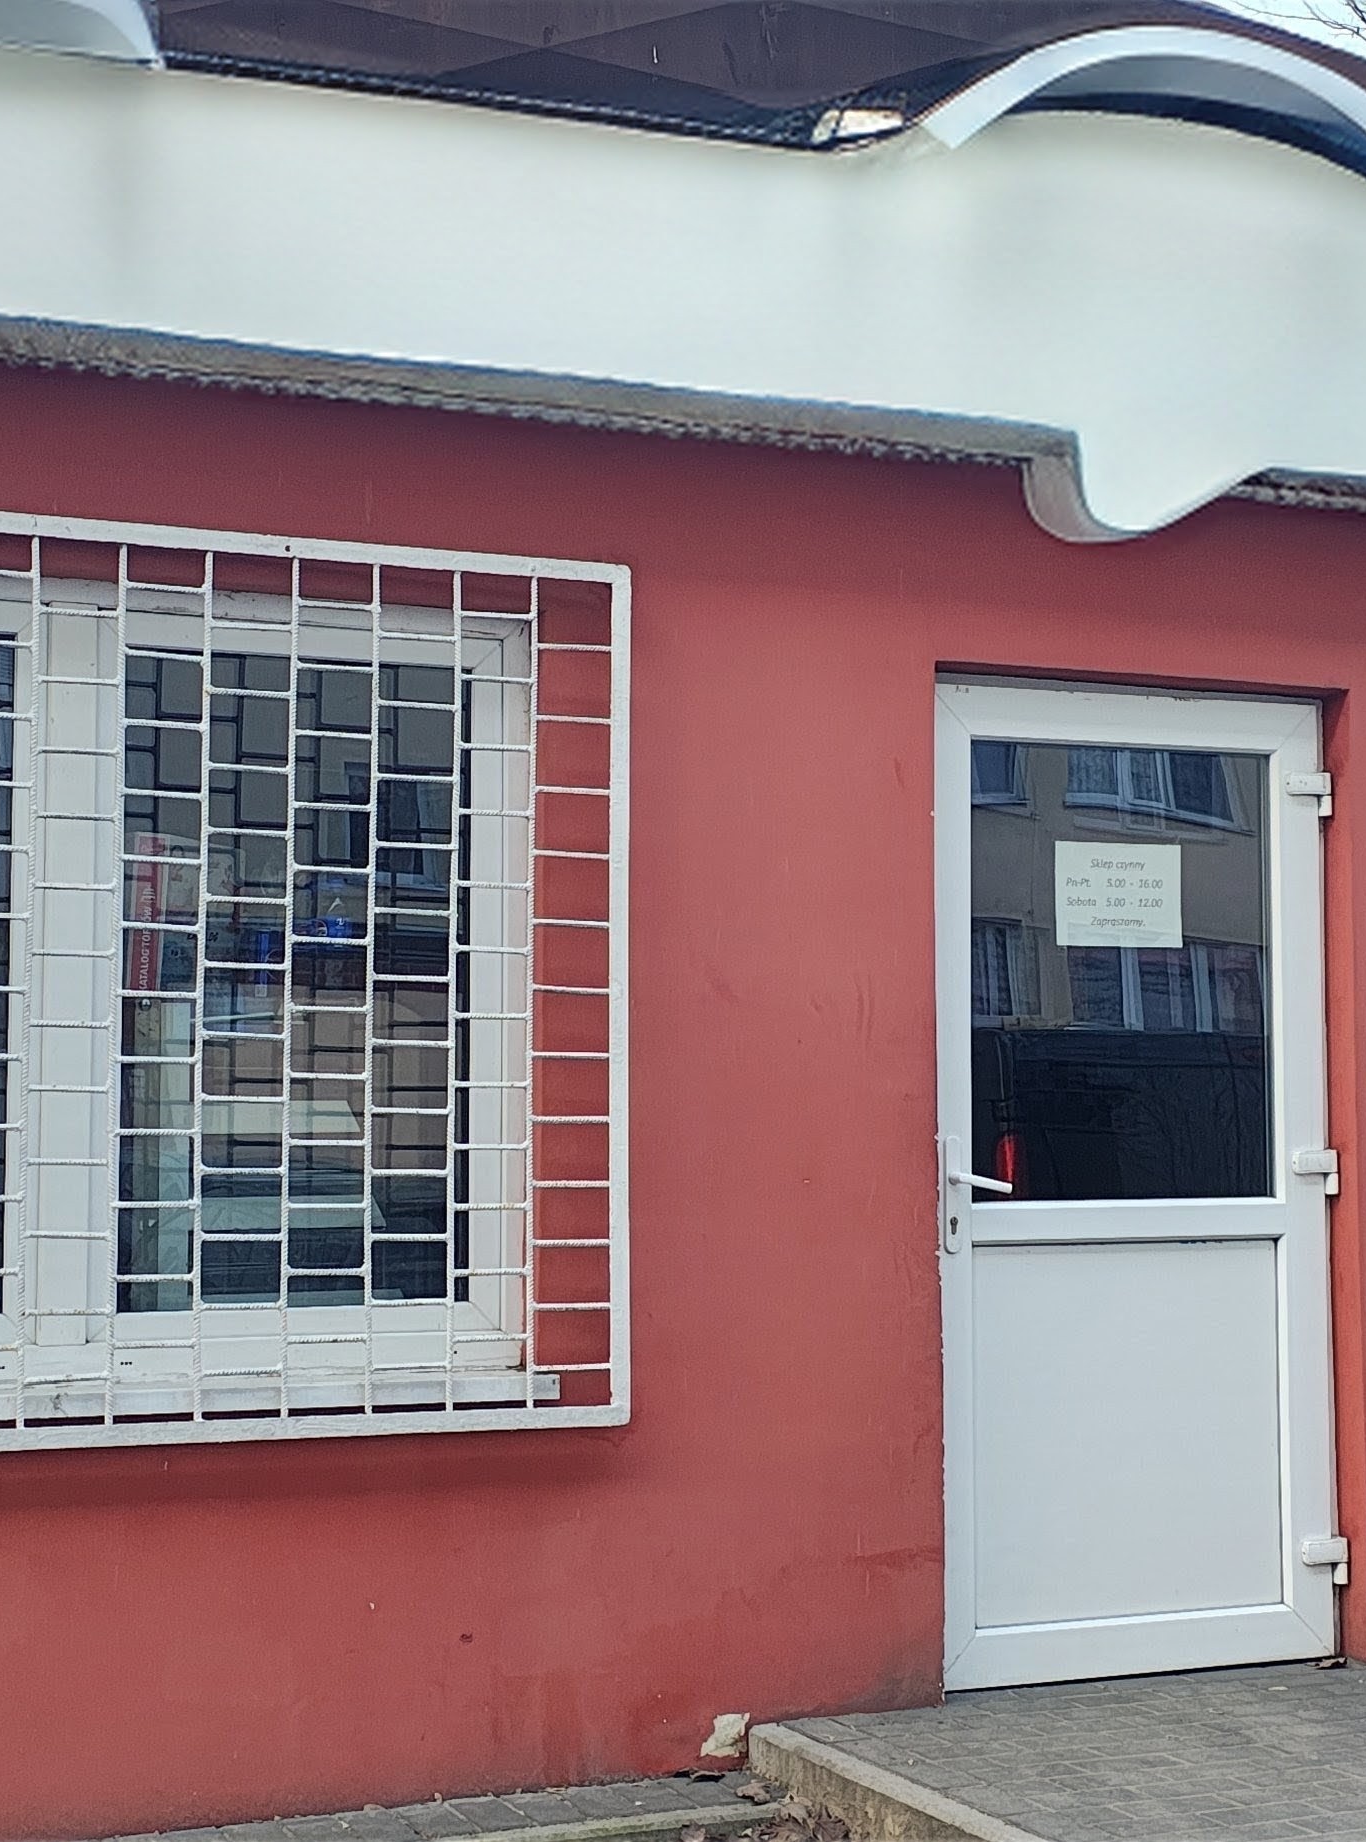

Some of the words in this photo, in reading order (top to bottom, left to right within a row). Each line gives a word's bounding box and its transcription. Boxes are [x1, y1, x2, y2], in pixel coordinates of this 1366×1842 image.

[1090, 859, 1113, 871] Sklep
[1115, 861, 1146, 871] czynny
[1066, 896, 1097, 907] Sobota
